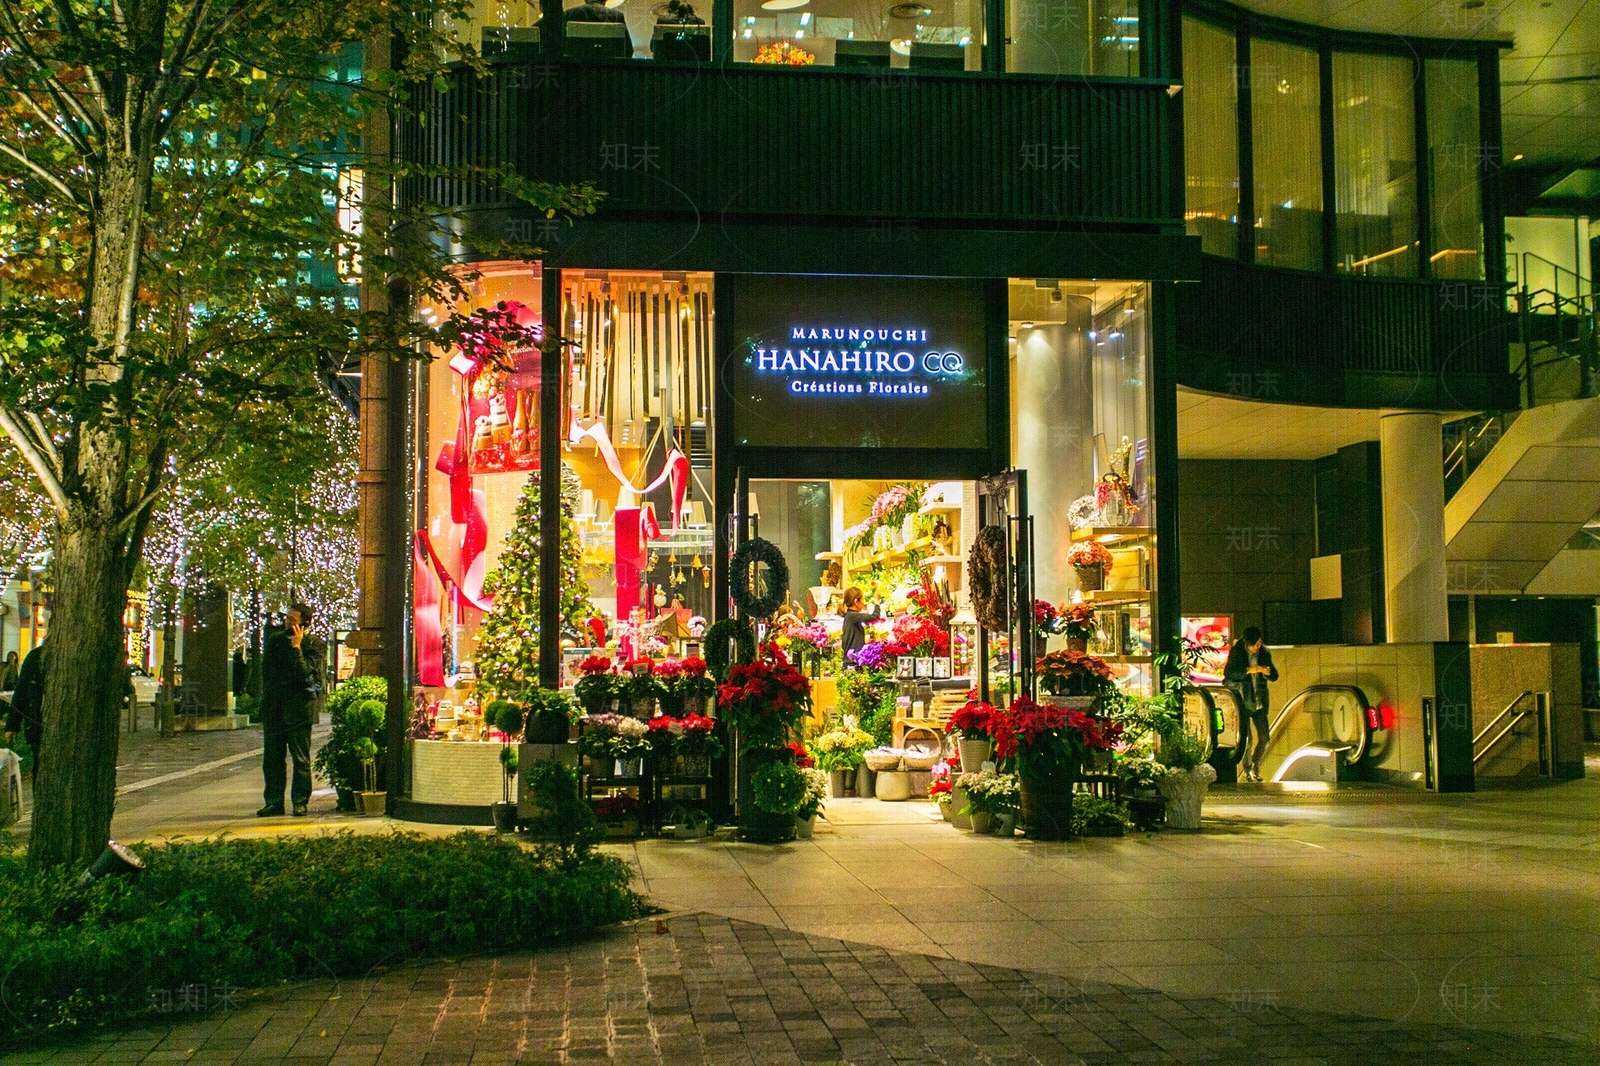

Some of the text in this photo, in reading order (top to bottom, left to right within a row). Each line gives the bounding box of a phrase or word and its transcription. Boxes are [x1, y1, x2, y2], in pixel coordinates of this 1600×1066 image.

[792, 328, 928, 341] MARUNOUCHI
[757, 349, 964, 375] HANAHIRO CQ
[791, 380, 928, 394] Créations Florales
